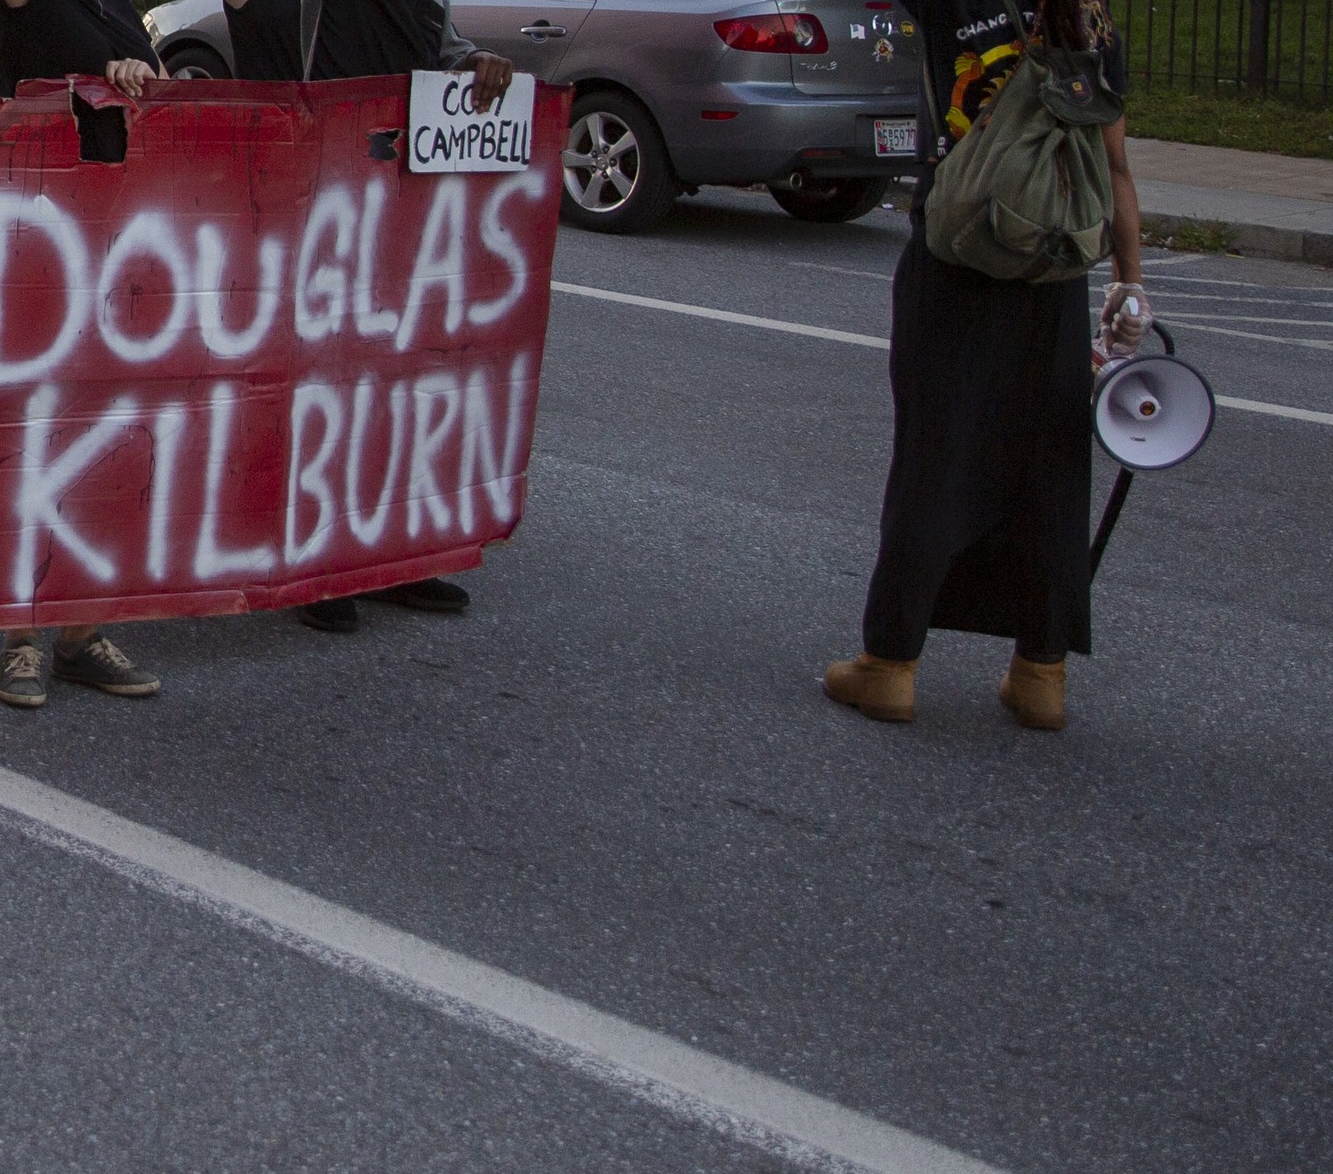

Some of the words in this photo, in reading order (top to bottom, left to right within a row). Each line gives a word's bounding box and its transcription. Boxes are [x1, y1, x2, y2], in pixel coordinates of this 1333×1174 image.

[442, 80, 506, 117] COY
[414, 120, 530, 165] CAMPBELL
[12, 357, 528, 602] KILBURN
